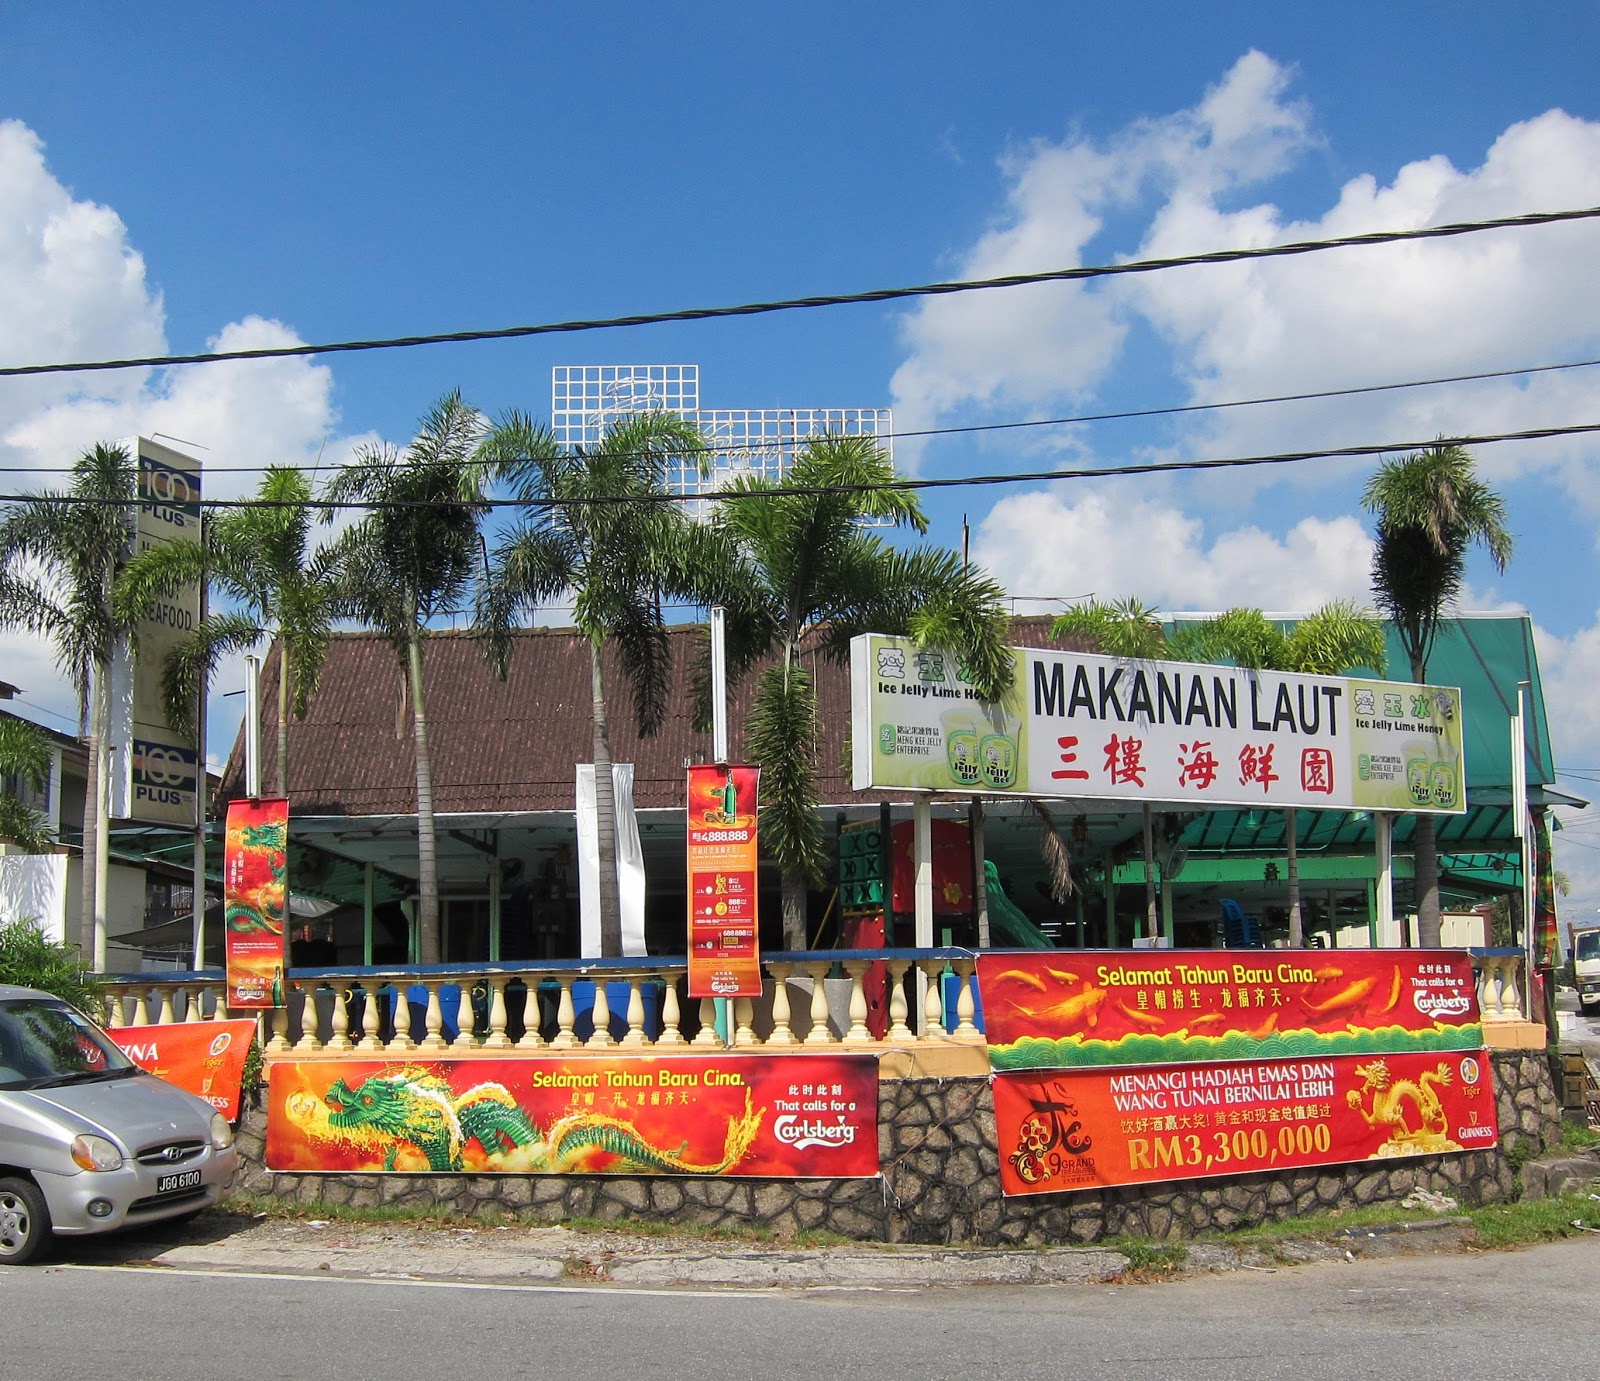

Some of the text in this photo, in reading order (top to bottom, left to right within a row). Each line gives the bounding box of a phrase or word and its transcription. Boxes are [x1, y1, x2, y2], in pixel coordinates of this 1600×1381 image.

[144, 461, 190, 508] 100
[142, 503, 185, 528] PLUS
[878, 682, 897, 694] Ice
[900, 683, 929, 698] Jelly
[932, 686, 961, 699] Lime
[1034, 661, 1342, 737] MAKANAN LAUT
[1356, 718, 1443, 735] Ice Jelly Lime Honey
[897, 735, 942, 746] MENG KEE JELLY
[897, 745, 930, 755] ENTERPRISE
[138, 745, 185, 786] 100
[954, 763, 978, 774] Jelly
[986, 767, 1009, 777] Jelly
[1051, 733, 1335, 795] 三樓海鮮園
[136, 786, 181, 805] PLUS
[701, 830, 748, 842] 4,888,888
[1096, 963, 1318, 986] Selamat Tahun Baru Cina.
[1410, 977, 1465, 986] That calls for a
[236, 985, 266, 1000] Carlsberg
[711, 981, 739, 993] Carlsberg
[1413, 989, 1470, 1018] Carlsberg
[202, 1057, 224, 1069] Tiger
[532, 1069, 745, 1088] Selamat Tahun Baru Cina.
[1109, 1062, 1335, 1093] MENANGI HADIAH EMAS DAN
[788, 1084, 841, 1096] 此时此刻
[1113, 1080, 1334, 1112] WANG TUNAI BERNILAI LEBIH
[1462, 1086, 1480, 1099] Tiger
[774, 1100, 856, 1111] That calls for a
[774, 1114, 856, 1150] Carlsberg
[1458, 1126, 1492, 1139] GUINNESS
[1127, 1123, 1331, 1171] RM3,300,000
[1049, 1152, 1095, 1176] 9 GRAND
[159, 1171, 200, 1191] JGQ 6100
